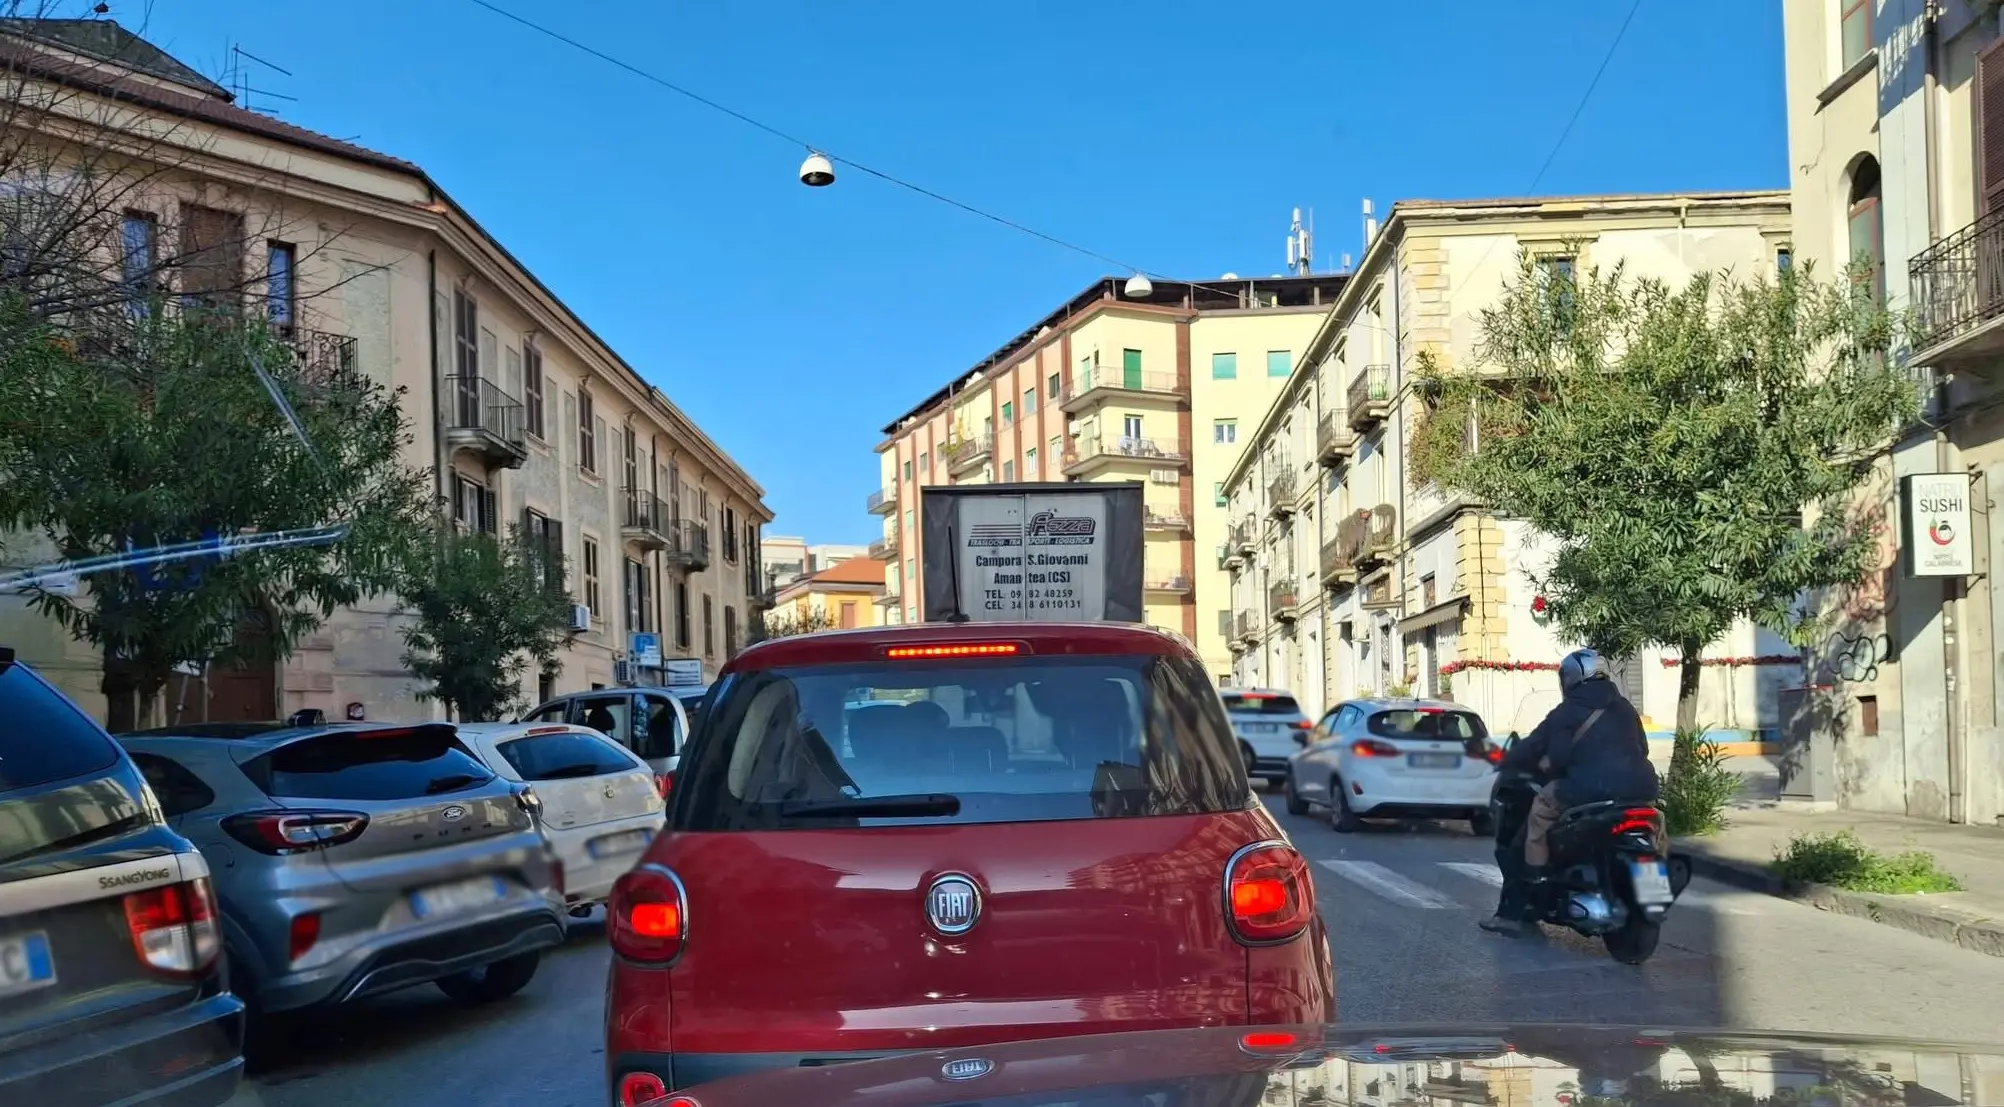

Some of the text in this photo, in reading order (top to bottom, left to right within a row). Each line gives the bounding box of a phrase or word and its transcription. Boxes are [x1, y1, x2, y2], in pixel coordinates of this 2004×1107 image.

[1920, 498, 1963, 513] SUSHI
[976, 554, 1089, 567] Campora S.Giovanni
[938, 892, 969, 918] FIAT
